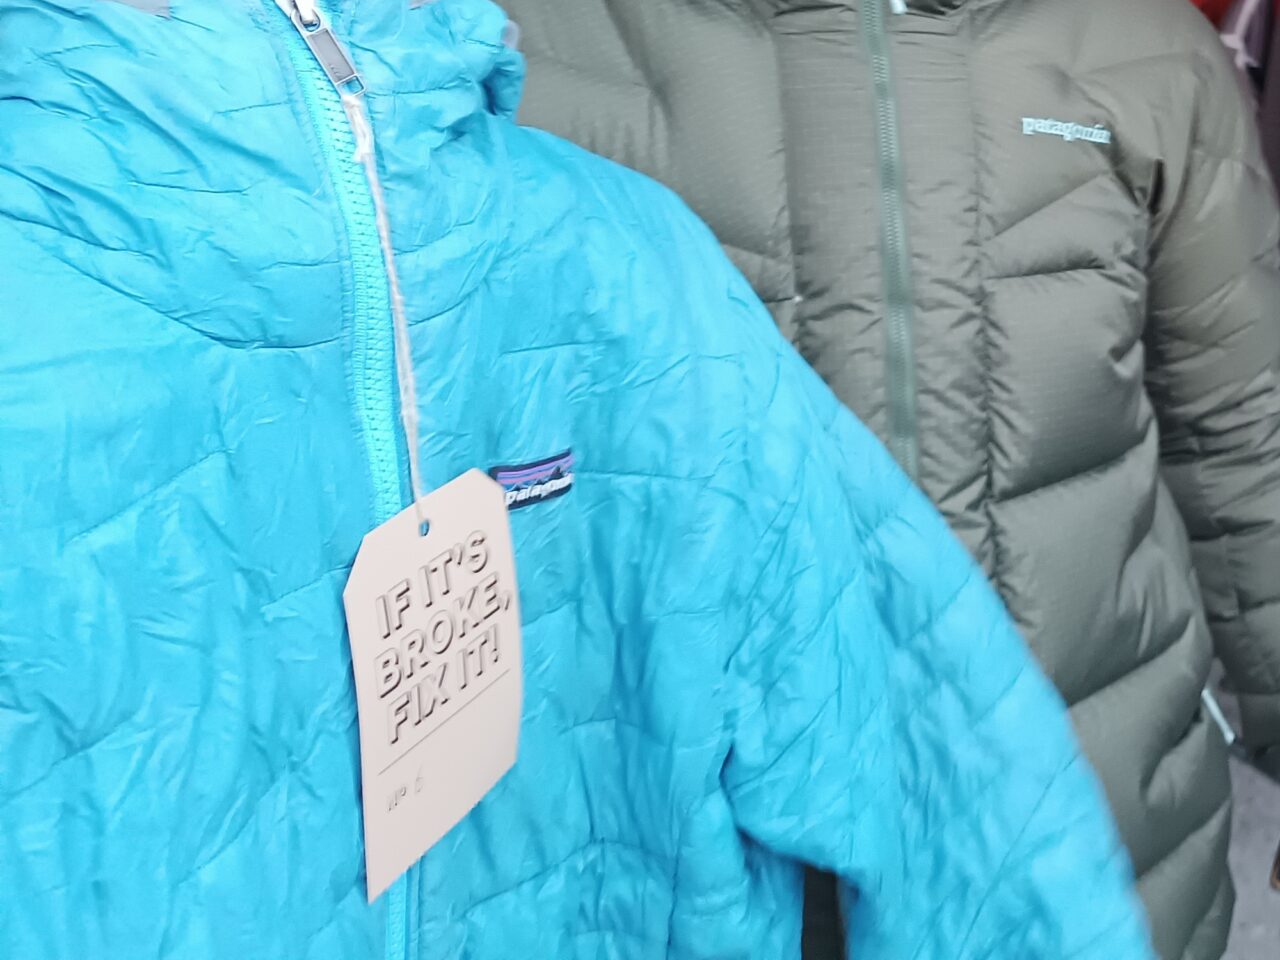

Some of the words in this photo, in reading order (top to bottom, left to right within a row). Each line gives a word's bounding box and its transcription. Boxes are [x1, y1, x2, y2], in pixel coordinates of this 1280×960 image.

[374, 570, 511, 700] BROKE,
[376, 577, 412, 640] IF
[419, 529, 489, 609] IT'S
[386, 662, 450, 745] FIX
[456, 623, 499, 691] IT!
